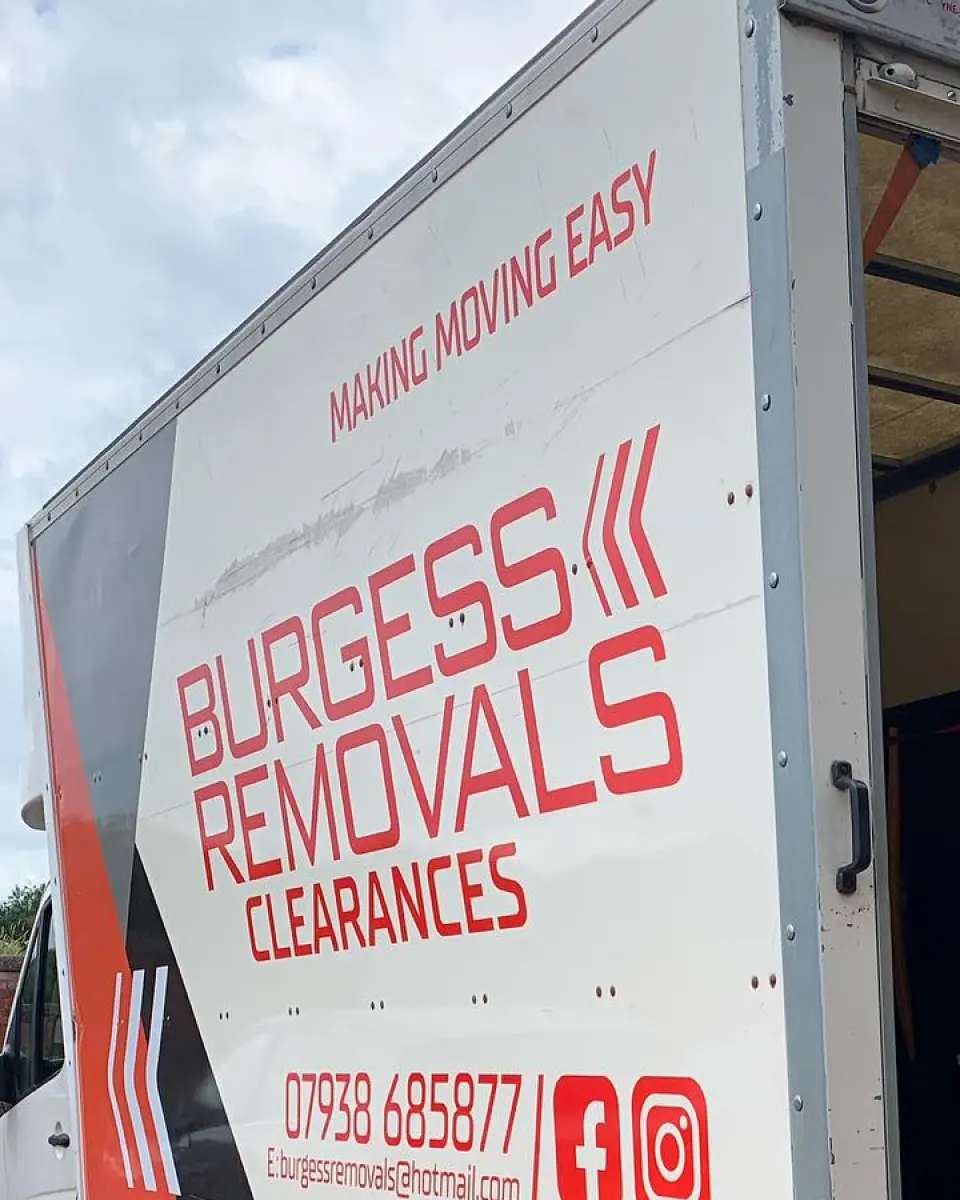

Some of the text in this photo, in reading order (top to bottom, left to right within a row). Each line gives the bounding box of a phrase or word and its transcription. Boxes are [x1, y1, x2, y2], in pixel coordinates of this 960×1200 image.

[330, 149, 657, 443] MAKING MOVING EASY
[177, 485, 574, 777] BURGESS
[194, 624, 685, 892] REMOVALS
[245, 841, 529, 962] CLEARANCES
[285, 1072, 523, 1154] 07938 685877
